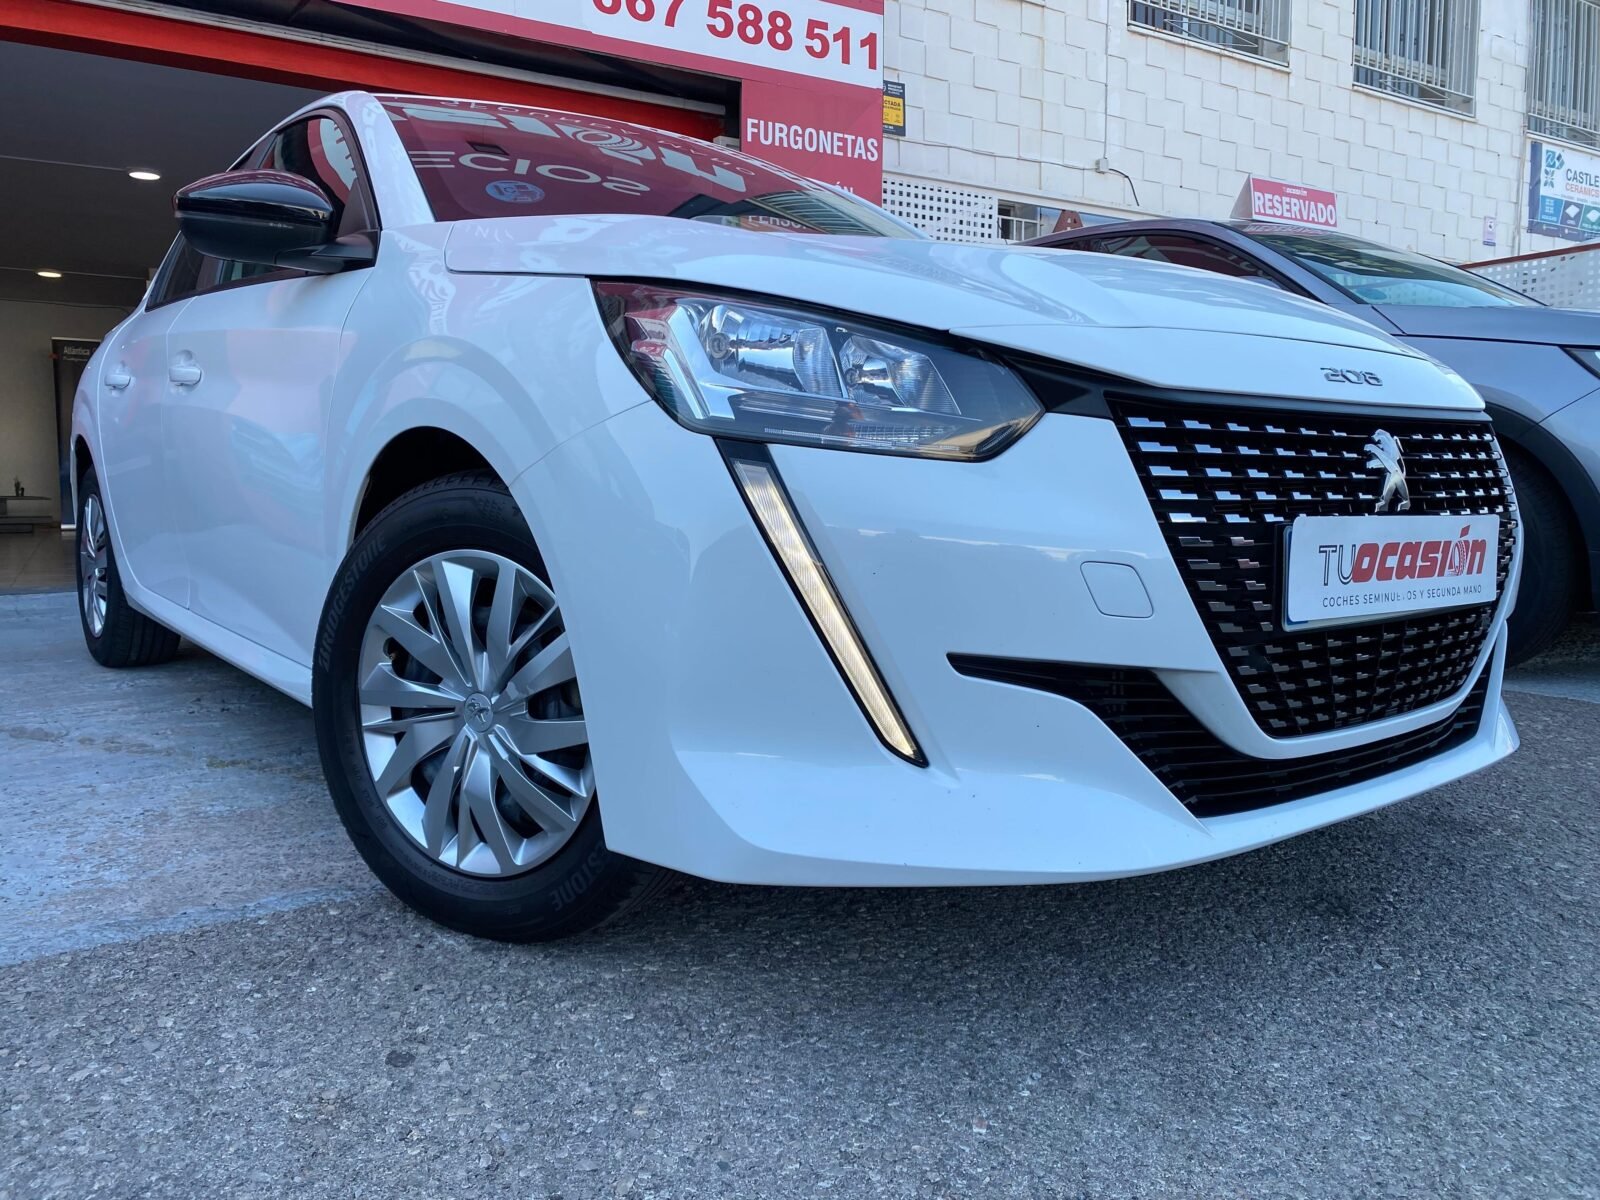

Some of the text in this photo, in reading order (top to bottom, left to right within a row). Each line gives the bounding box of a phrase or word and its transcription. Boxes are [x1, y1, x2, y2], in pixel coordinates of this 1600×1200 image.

[706, 0, 793, 51] 588
[804, 18, 878, 70] 511
[746, 118, 879, 162] FURGONETAS
[1253, 191, 1336, 225] RESERVADO
[1320, 367, 1383, 387] 208
[318, 532, 387, 673] BRIDGESTONE
[1322, 584, 1483, 608] COCHES SEMINUEOS Y SEGUNDA MANO
